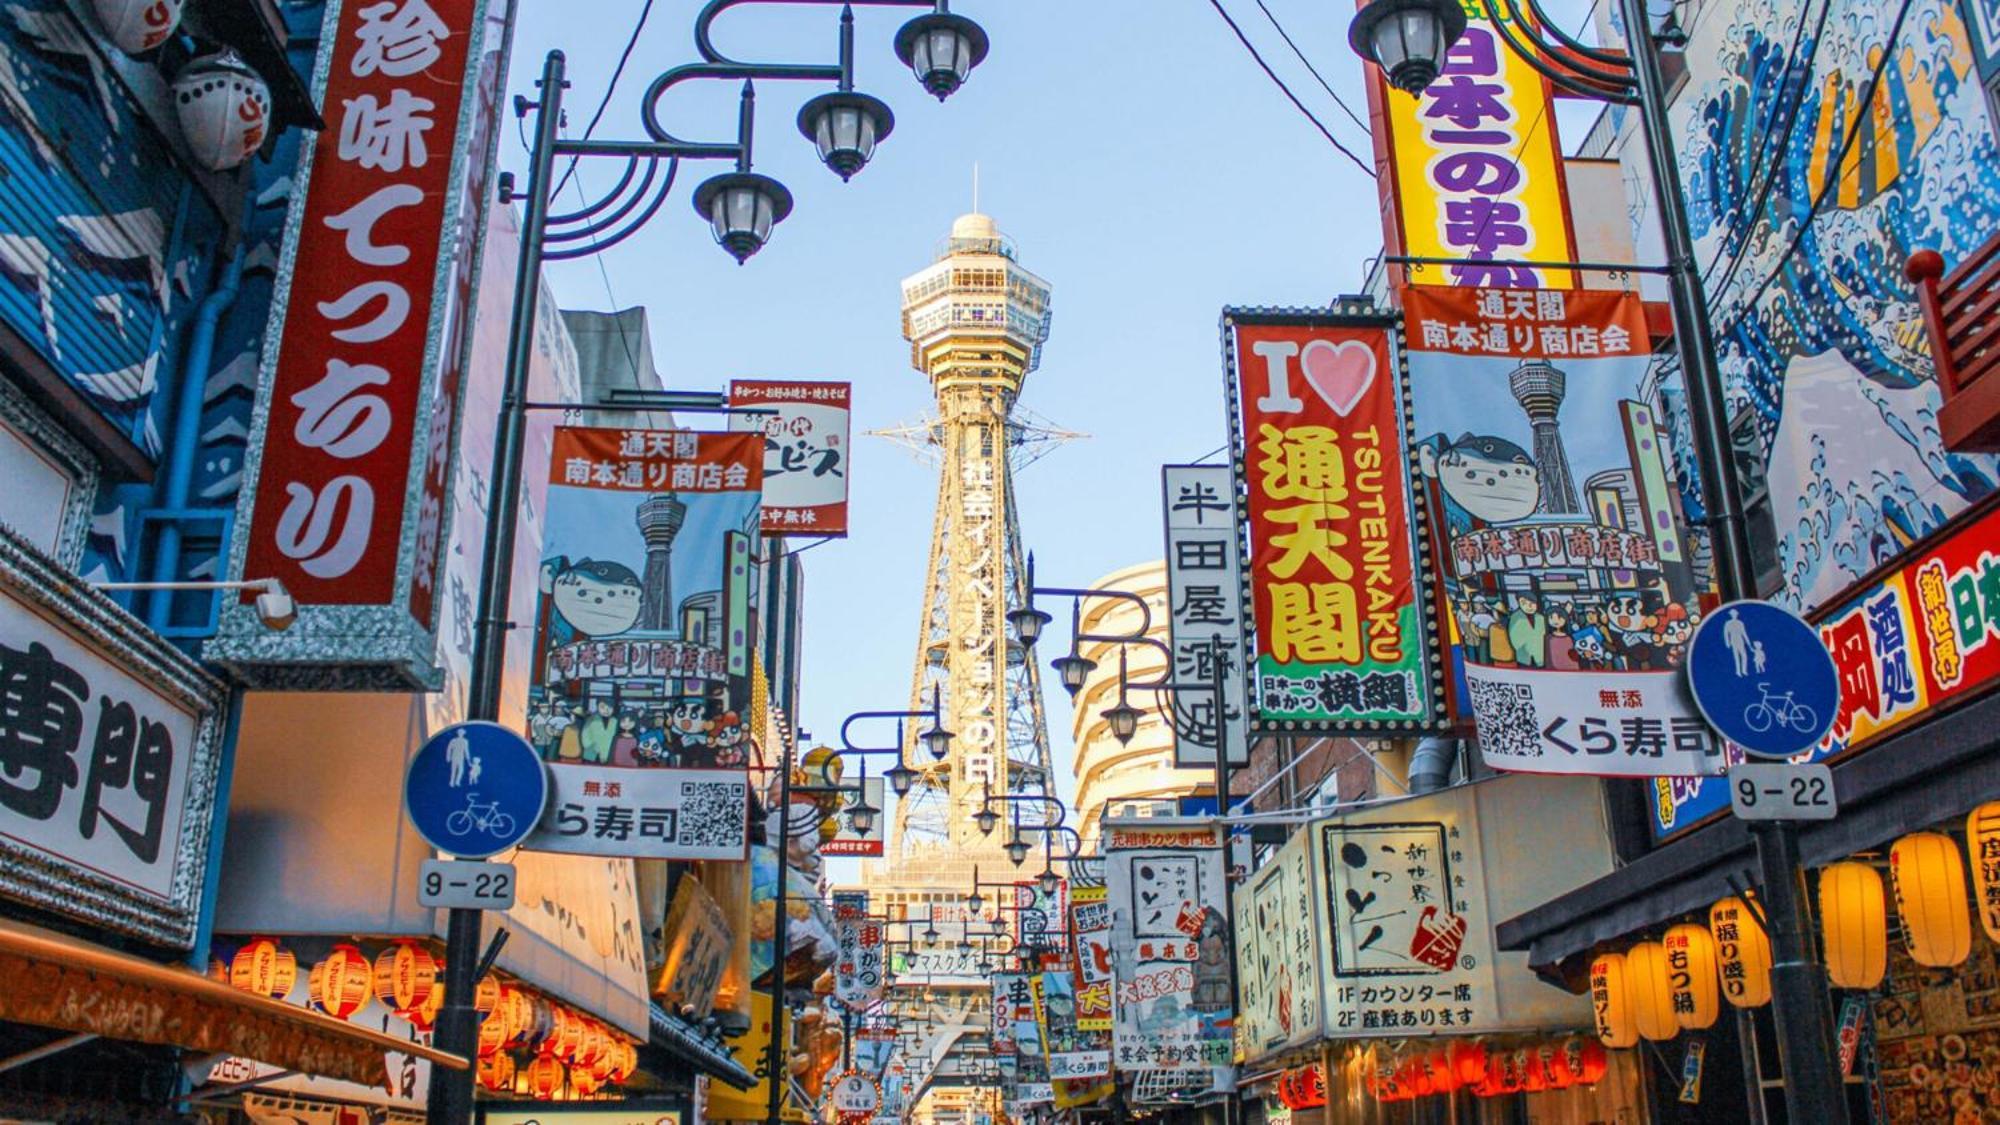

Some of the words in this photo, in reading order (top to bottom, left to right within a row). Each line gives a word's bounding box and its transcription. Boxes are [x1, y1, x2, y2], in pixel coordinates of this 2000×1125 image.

[1477, 290, 1565, 321] 通天閣
[1421, 319, 1631, 355] 南本通り商店会
[1252, 340, 1303, 414] I
[620, 431, 698, 459] 通天閣
[565, 458, 748, 489] 南本通り商店会
[1258, 423, 1361, 664] 通天閣
[1352, 424, 1402, 660] TSUTENKAKU
[1457, 529, 1658, 564] 南本通り商店街
[1919, 563, 1959, 684] 新世界
[1264, 677, 1316, 690] 日本一の
[1600, 689, 1643, 708] 無添
[1265, 693, 1316, 710] 串かつ
[1541, 716, 1721, 758] くら寿司
[583, 781, 621, 797] 無添
[1739, 777, 1829, 807] 9-22
[426, 872, 509, 898] 9-22
[1717, 924, 1745, 996] 握り盛り
[1361, 984, 1472, 1002] カウンター席
[1670, 950, 1695, 1014] もつ鍋
[1363, 1008, 1473, 1028] 座敷あります
[1119, 1043, 1229, 1063] 宴会予約受付中
